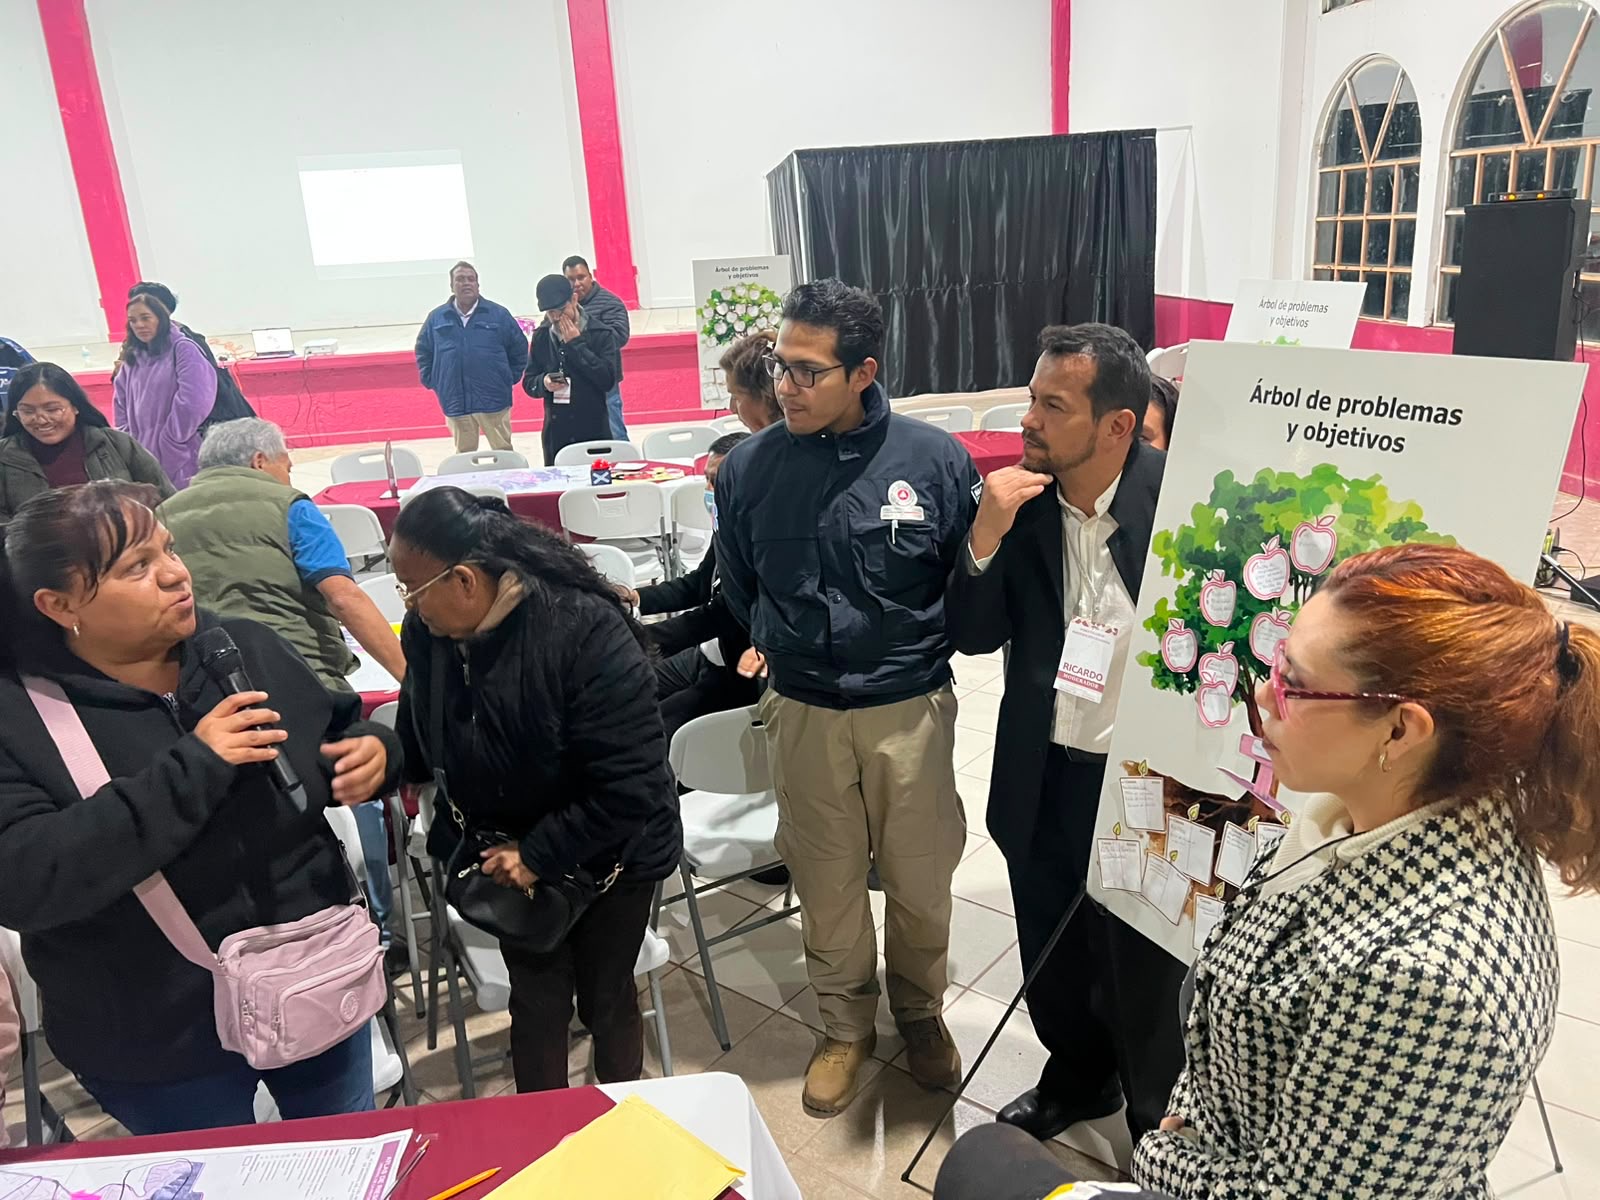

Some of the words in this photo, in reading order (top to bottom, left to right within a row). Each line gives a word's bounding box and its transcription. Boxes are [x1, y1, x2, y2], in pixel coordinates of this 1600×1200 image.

[1258, 296, 1278, 310] Árbol
[1278, 299, 1287, 310] de
[1288, 300, 1329, 314] problemas
[1269, 315, 1275, 327] y
[1275, 314, 1309, 328] objetivos
[1250, 378, 1302, 407] Árbol
[1306, 389, 1332, 411] de
[1336, 395, 1463, 425] problemas
[1286, 422, 1299, 442] y
[1304, 422, 1405, 453] objetivos
[1062, 662, 1103, 681] RICARDO
